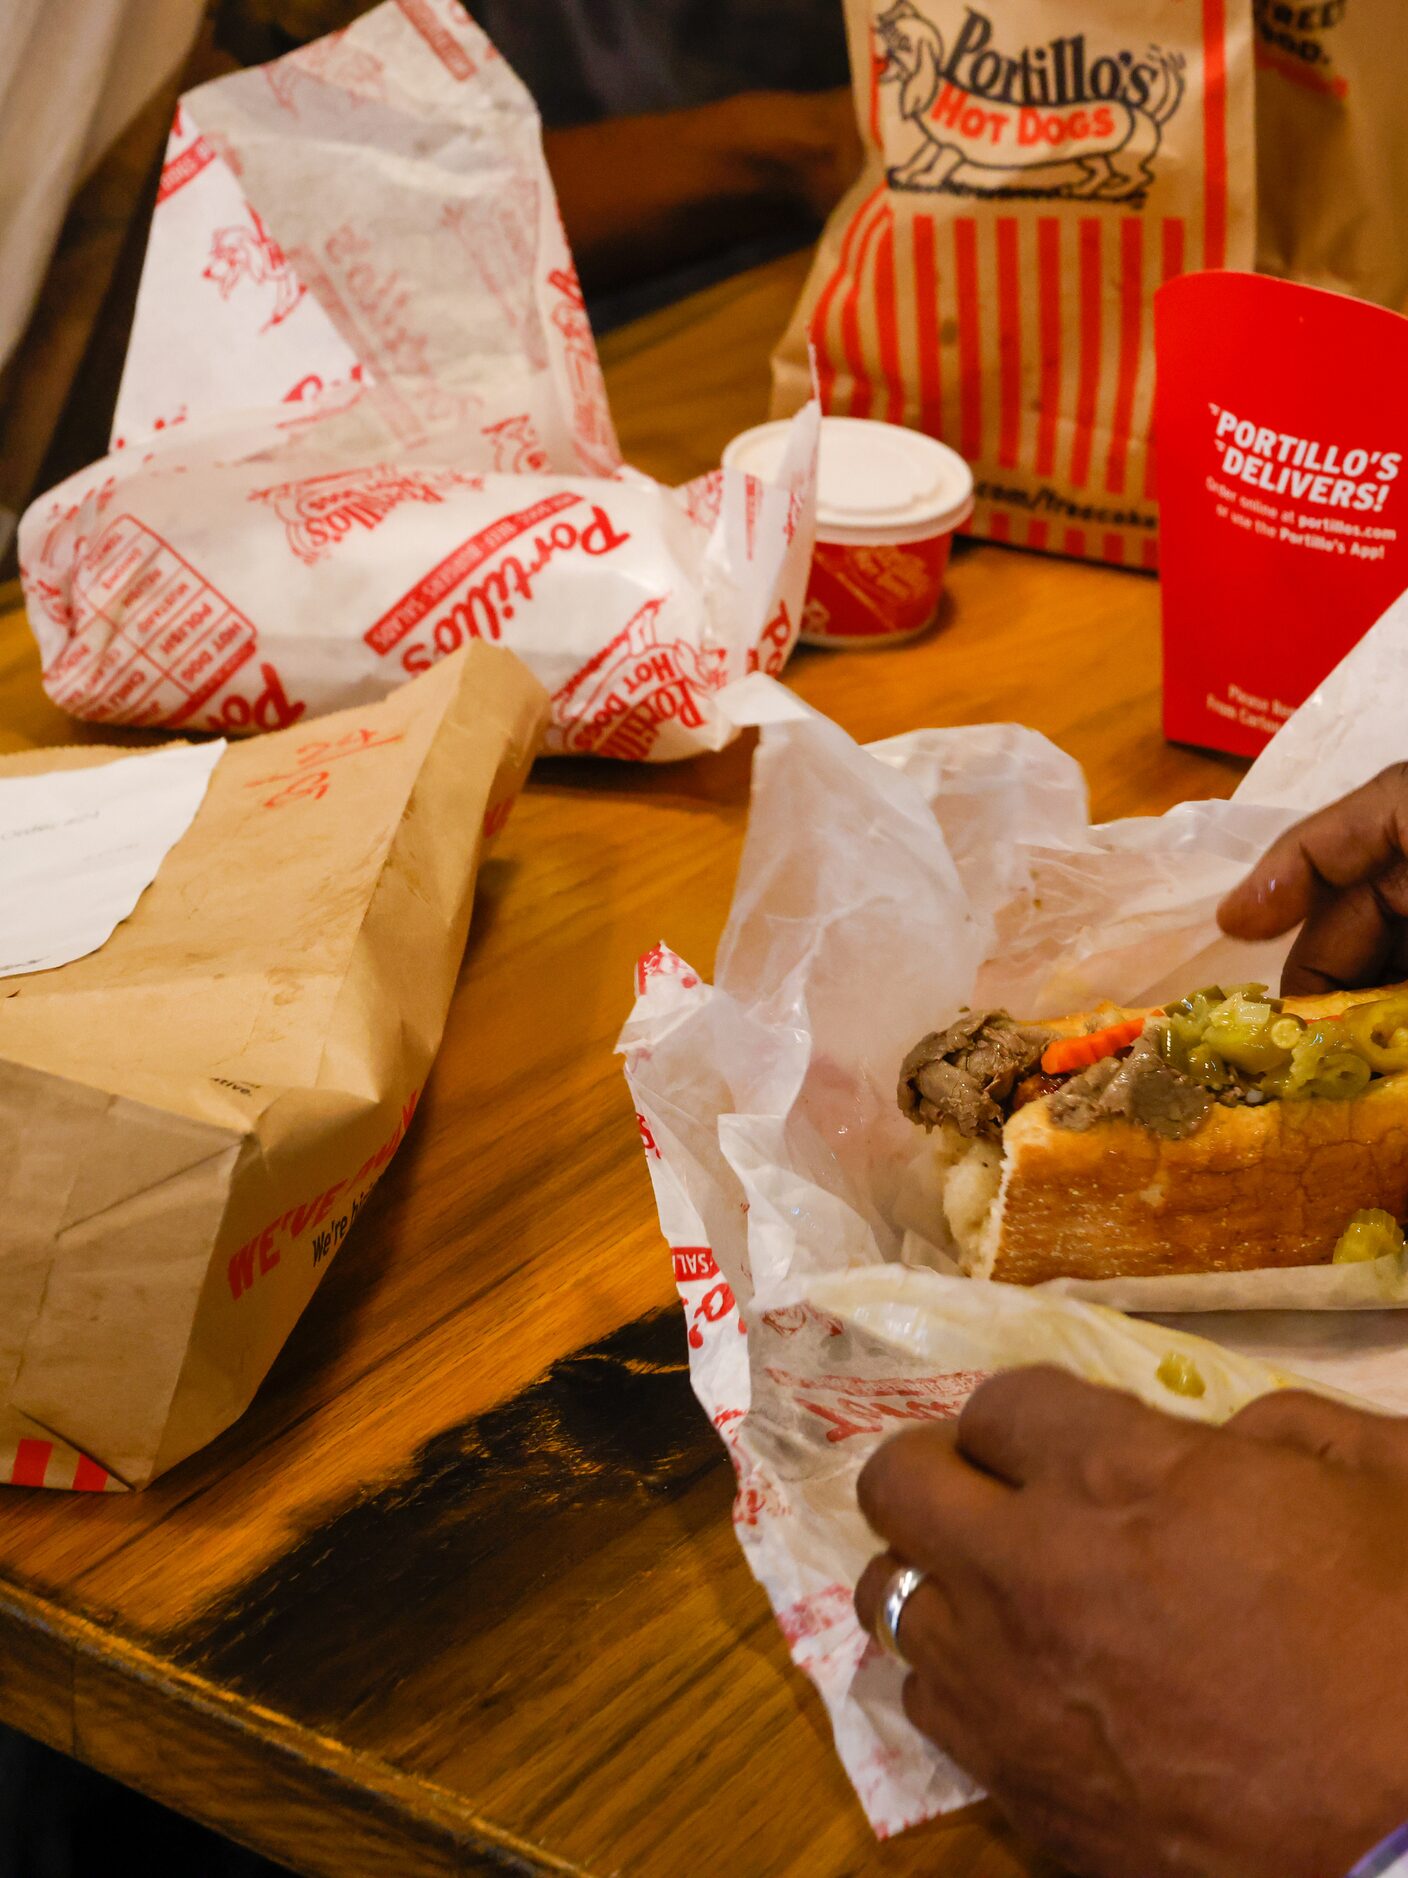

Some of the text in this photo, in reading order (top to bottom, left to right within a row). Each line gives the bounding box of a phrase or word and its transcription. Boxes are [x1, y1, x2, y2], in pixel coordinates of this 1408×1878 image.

[944, 4, 1158, 108] Portillo's
[930, 82, 1117, 148] HOT DOGS
[1215, 405, 1403, 482] PORTILLO'S
[1221, 445, 1391, 513] DELIVERS!
[1239, 496, 1279, 520] online
[1280, 510, 1296, 526] at
[1254, 519, 1277, 540] the
[402, 505, 631, 673] Portillos
[623, 652, 677, 696] HOT
[311, 1215, 348, 1268] We're
